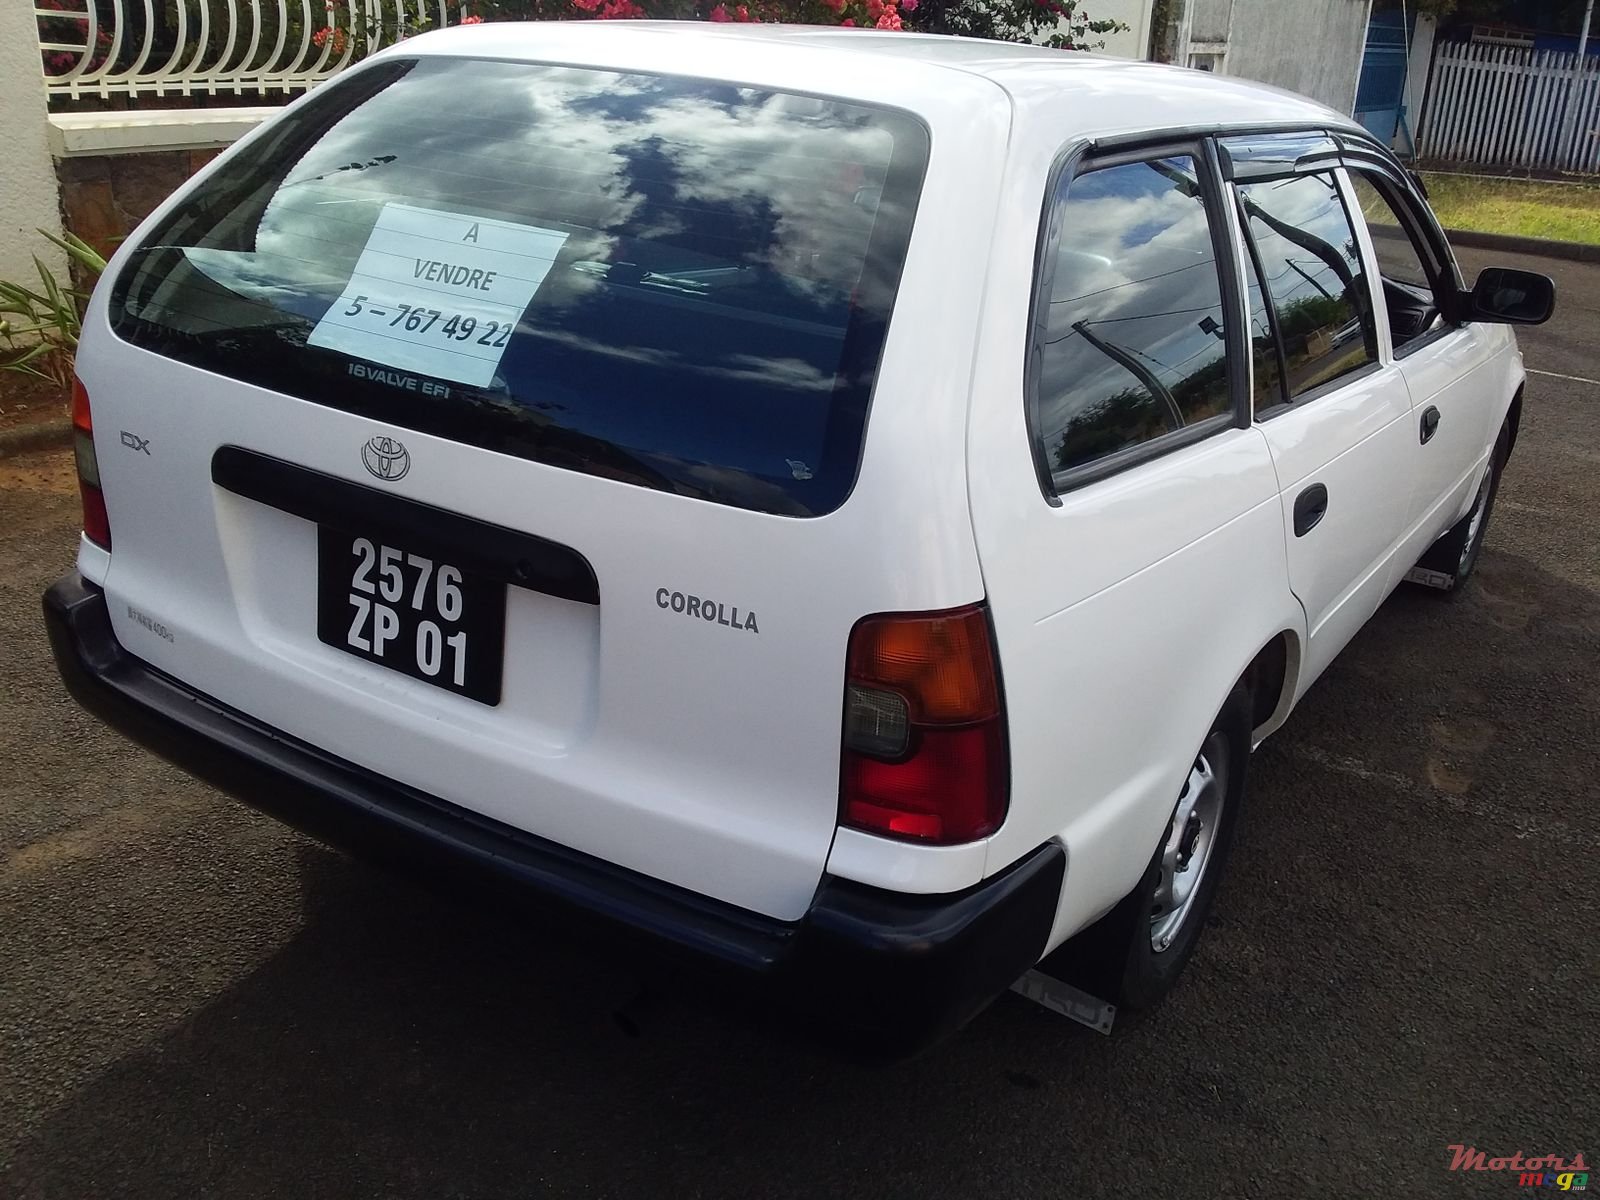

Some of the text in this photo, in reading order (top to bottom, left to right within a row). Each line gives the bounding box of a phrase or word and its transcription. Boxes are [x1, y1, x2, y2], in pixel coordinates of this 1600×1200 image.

[463, 223, 480, 242] A
[413, 259, 497, 291] VENDRE
[344, 295, 369, 317] 5
[389, 304, 442, 333] 767
[442, 314, 477, 341] 49
[477, 322, 514, 348] 22
[422, 381, 451, 399] EFI
[119, 430, 151, 456] DX
[352, 537, 463, 622] 2576
[655, 587, 760, 634] COROLLA
[348, 593, 467, 687] ZP 01
